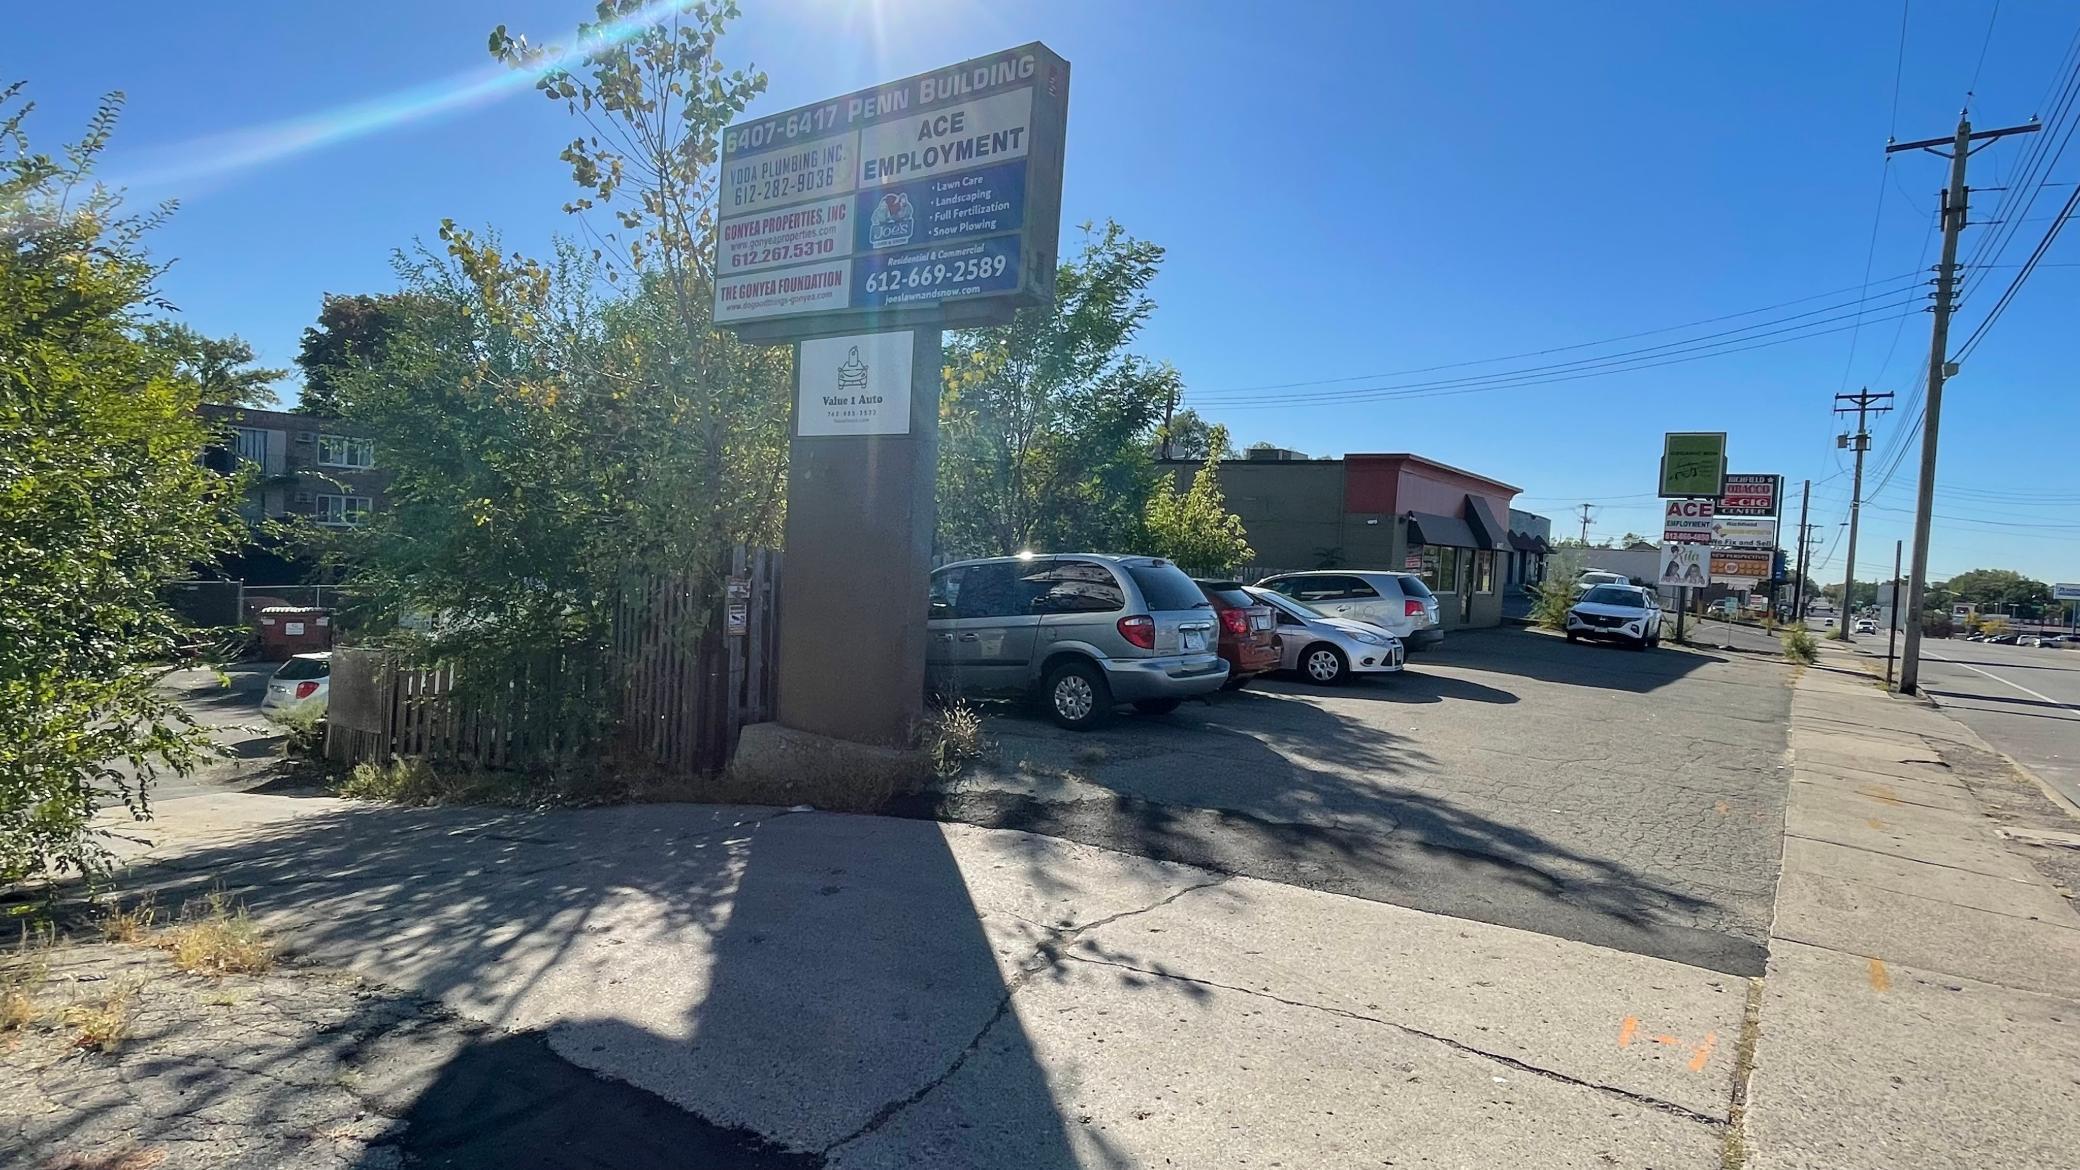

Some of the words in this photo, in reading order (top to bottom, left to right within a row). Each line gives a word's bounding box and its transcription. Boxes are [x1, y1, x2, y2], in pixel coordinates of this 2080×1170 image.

[726, 104, 837, 153] 6407-6417
[848, 88, 910, 123] PENN
[919, 54, 1035, 105] BUILDING
[917, 111, 965, 141] ACE
[762, 150, 818, 179] PLUMBING
[823, 144, 847, 166] INC.
[864, 127, 1025, 181] EMPLOYMENT
[735, 167, 834, 206] 612-282-9036
[936, 181, 960, 192] Lawn
[962, 176, 984, 186] Care
[935, 189, 992, 207] Landscaping
[724, 221, 760, 241] GONYEA
[827, 204, 847, 223] INC
[934, 210, 951, 222] Full
[953, 200, 1010, 219] Fertilization
[933, 225, 958, 237] Snow
[959, 219, 997, 233] Plowing
[731, 238, 834, 267] 612.267.5310
[887, 252, 929, 267] Residential
[930, 250, 936, 260] &
[938, 243, 985, 259] Commercial
[865, 254, 1007, 293] 612-669-2589
[720, 285, 737, 302] THE
[738, 280, 776, 300] GONYEA
[778, 270, 843, 294] FOUNDATION
[885, 285, 981, 306] joeslawnandsnow.com
[823, 396, 848, 405] Value
[859, 394, 883, 404] Auto
[1727, 484, 1770, 494] OBACCO
[1667, 502, 1713, 517] ACE
[1721, 498, 1769, 507] E-CIG
[1667, 520, 1710, 528] EMPLOYMENT
